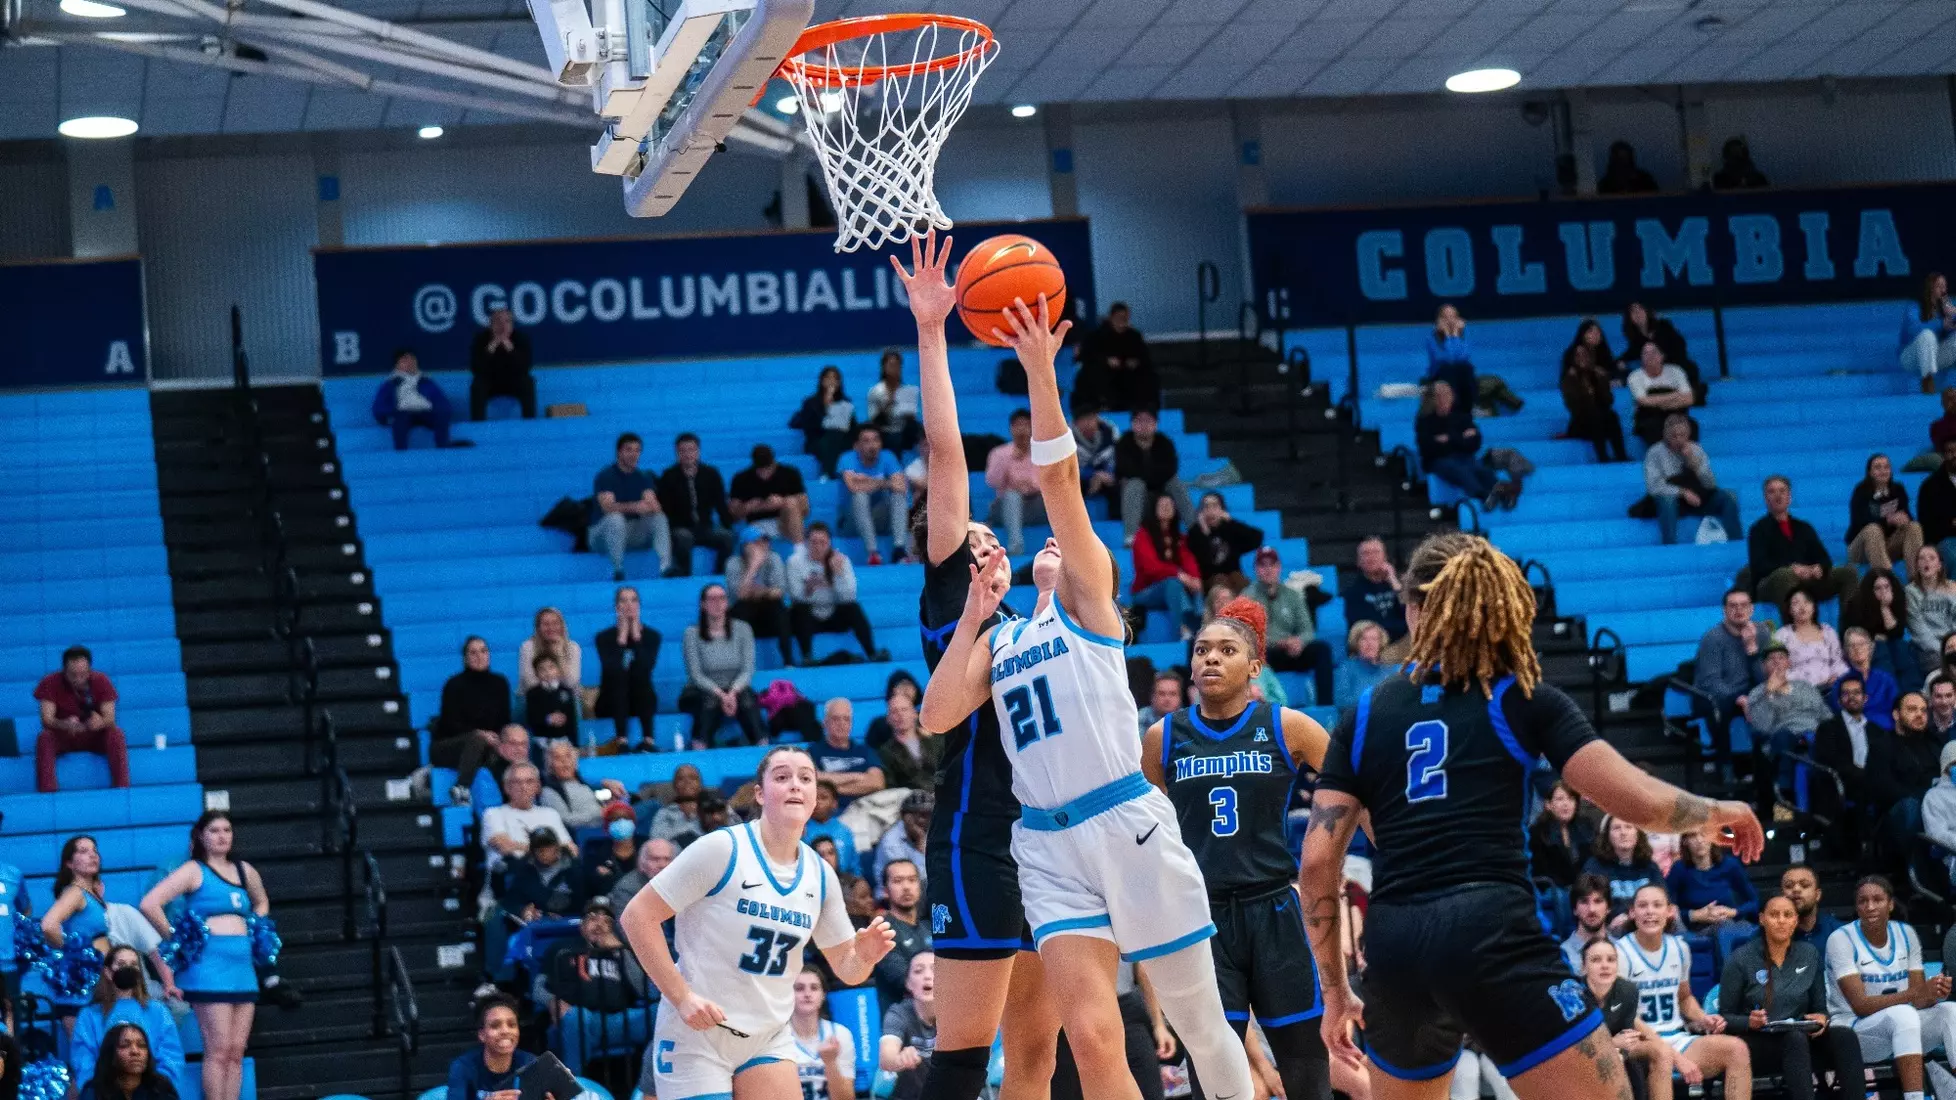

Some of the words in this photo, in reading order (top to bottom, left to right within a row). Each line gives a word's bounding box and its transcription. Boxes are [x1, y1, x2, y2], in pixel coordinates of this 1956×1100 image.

[1356, 209, 1911, 300] COLUMBIA
[105, 340, 134, 373] A
[333, 331, 360, 364] B
[1002, 674, 1063, 753] 21
[1174, 750, 1272, 782] Memphis
[1405, 719, 1448, 803] 2
[1208, 786, 1239, 837] 3
[230, 891, 242, 908] C
[738, 925, 802, 976] 33
[1641, 992, 1674, 1023] 35
[657, 1040, 675, 1074] C
